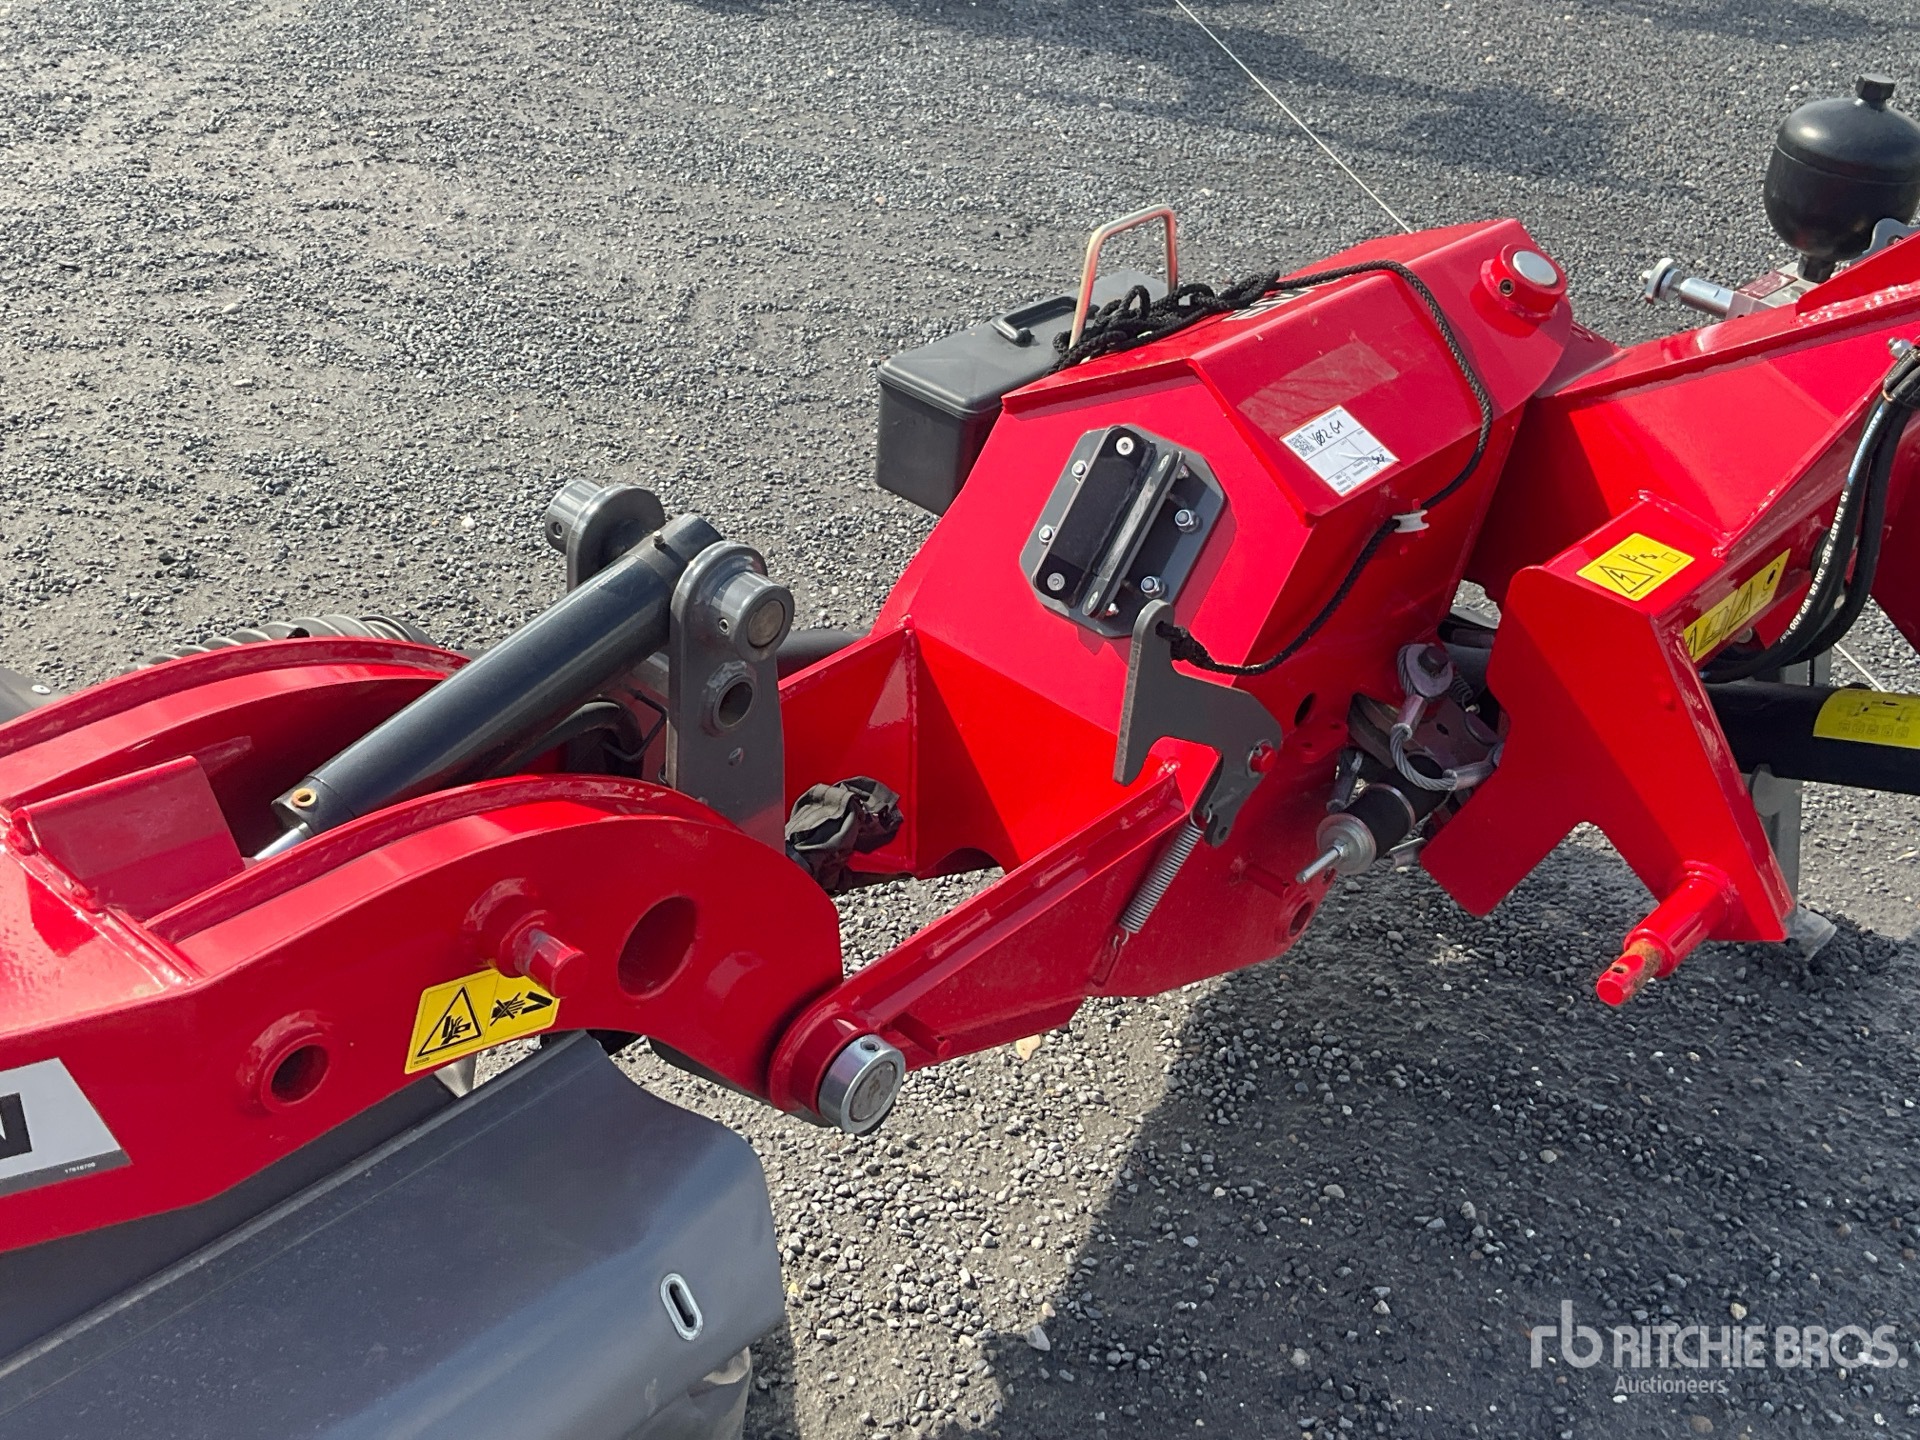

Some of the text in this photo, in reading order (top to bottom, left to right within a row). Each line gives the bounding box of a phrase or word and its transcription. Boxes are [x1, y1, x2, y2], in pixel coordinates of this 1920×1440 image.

[1840, 491, 1849, 502] 10
[1834, 506, 1844, 522] EN
[1830, 522, 1839, 541] 857
[1821, 544, 1833, 565] 2SC
[1814, 567, 1825, 584] DN
[1809, 583, 1819, 596] 06
[1800, 598, 1812, 615] WP
[1789, 613, 1802, 631] 400
[1779, 629, 1793, 644] bar
